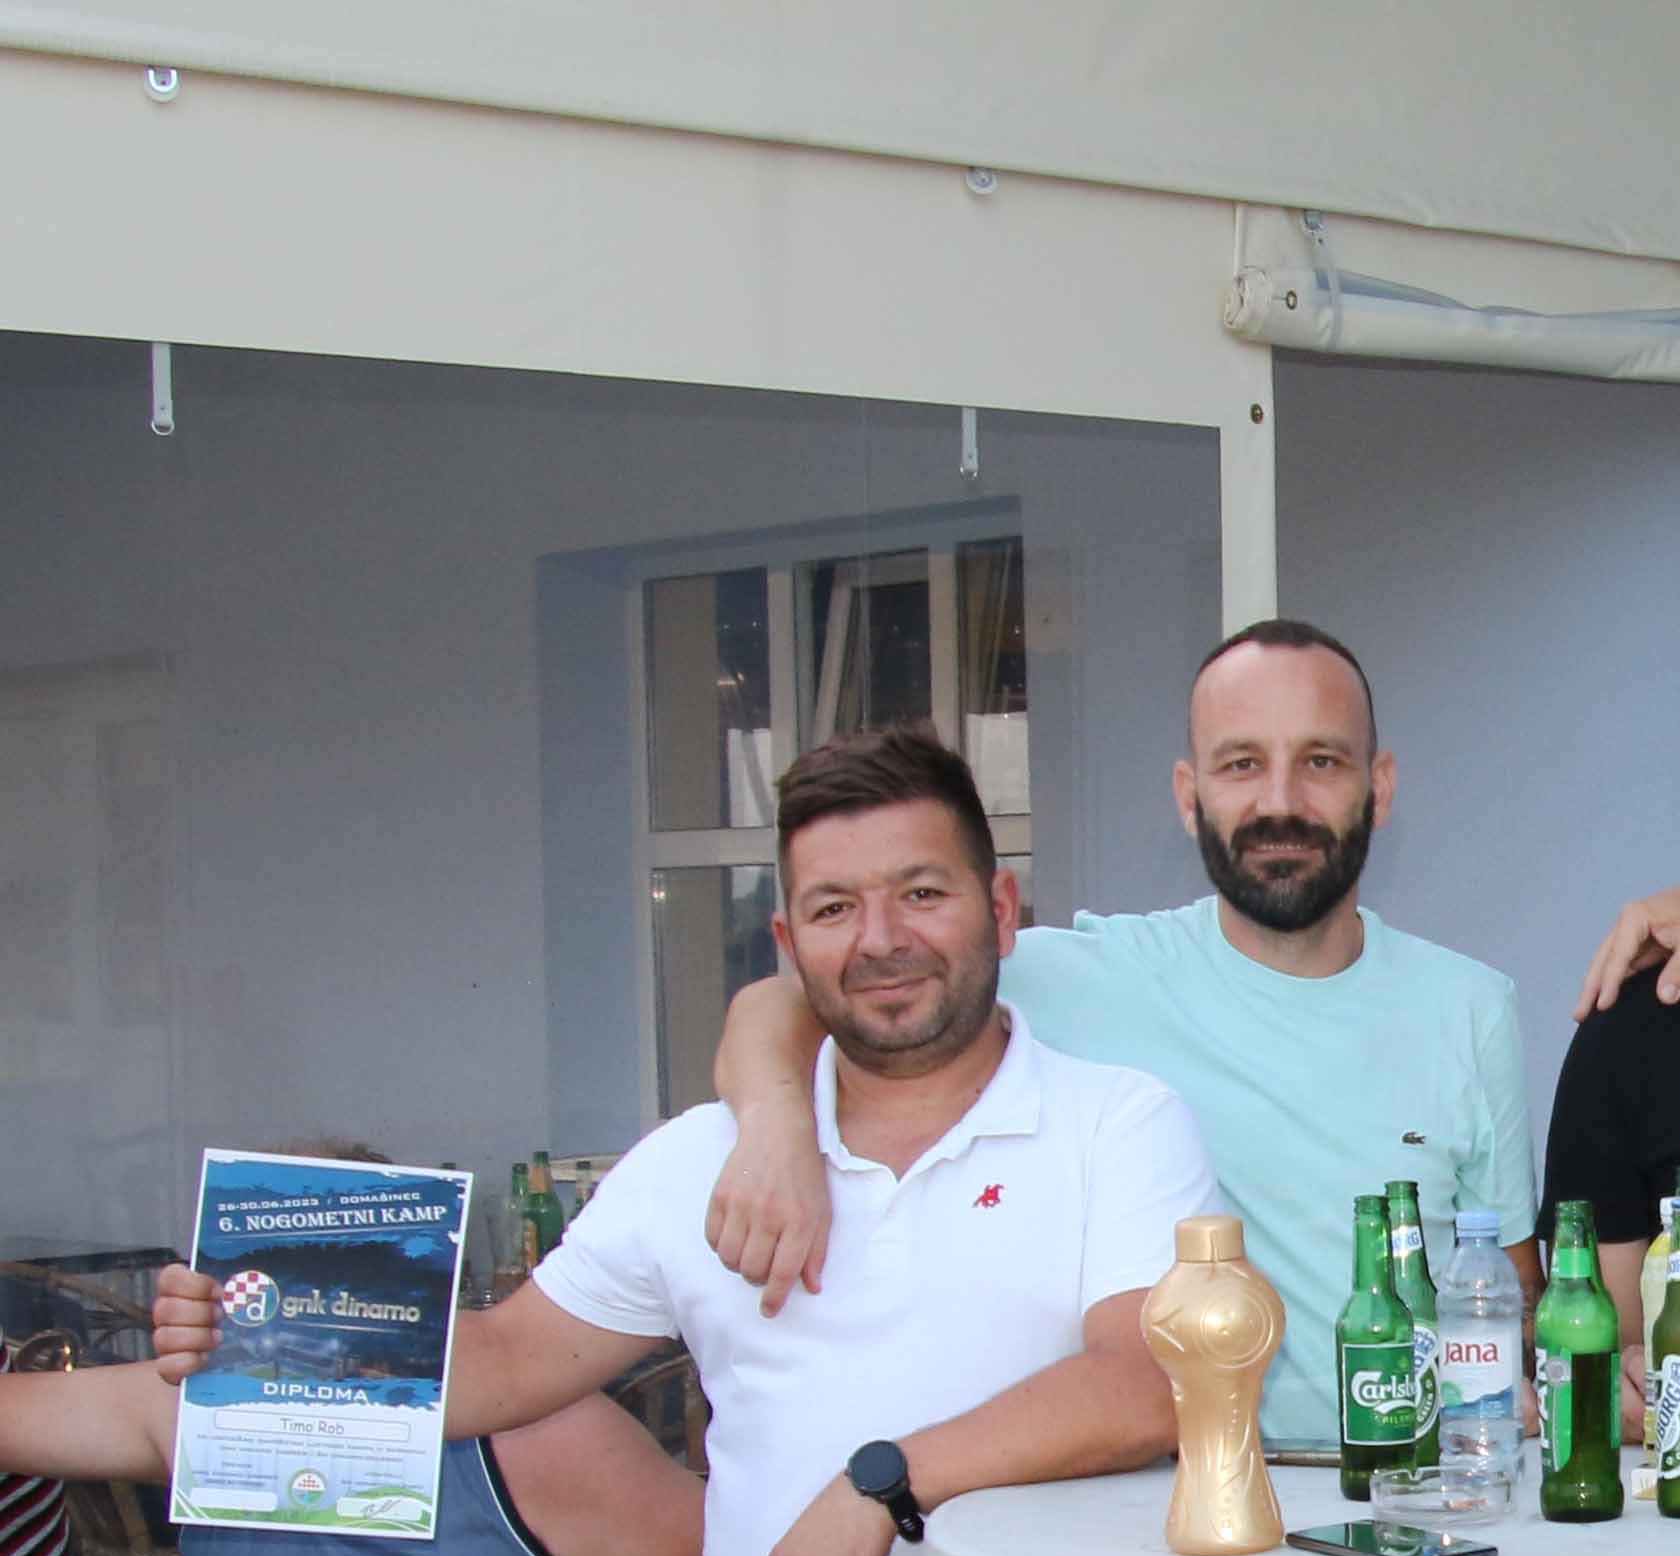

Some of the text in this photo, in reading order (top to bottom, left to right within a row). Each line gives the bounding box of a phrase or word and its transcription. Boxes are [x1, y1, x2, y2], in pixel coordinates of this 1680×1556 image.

[217, 1198, 320, 1212] 26-30.06.2023
[340, 1192, 421, 1205] DOMAŠINEC
[218, 1205, 447, 1232] 6. NOGOMETNI KAMP
[282, 1289, 421, 1323] gnk dinamo
[263, 1382, 369, 1402] DIPLOMA
[280, 1417, 345, 1436] Timo Rob
